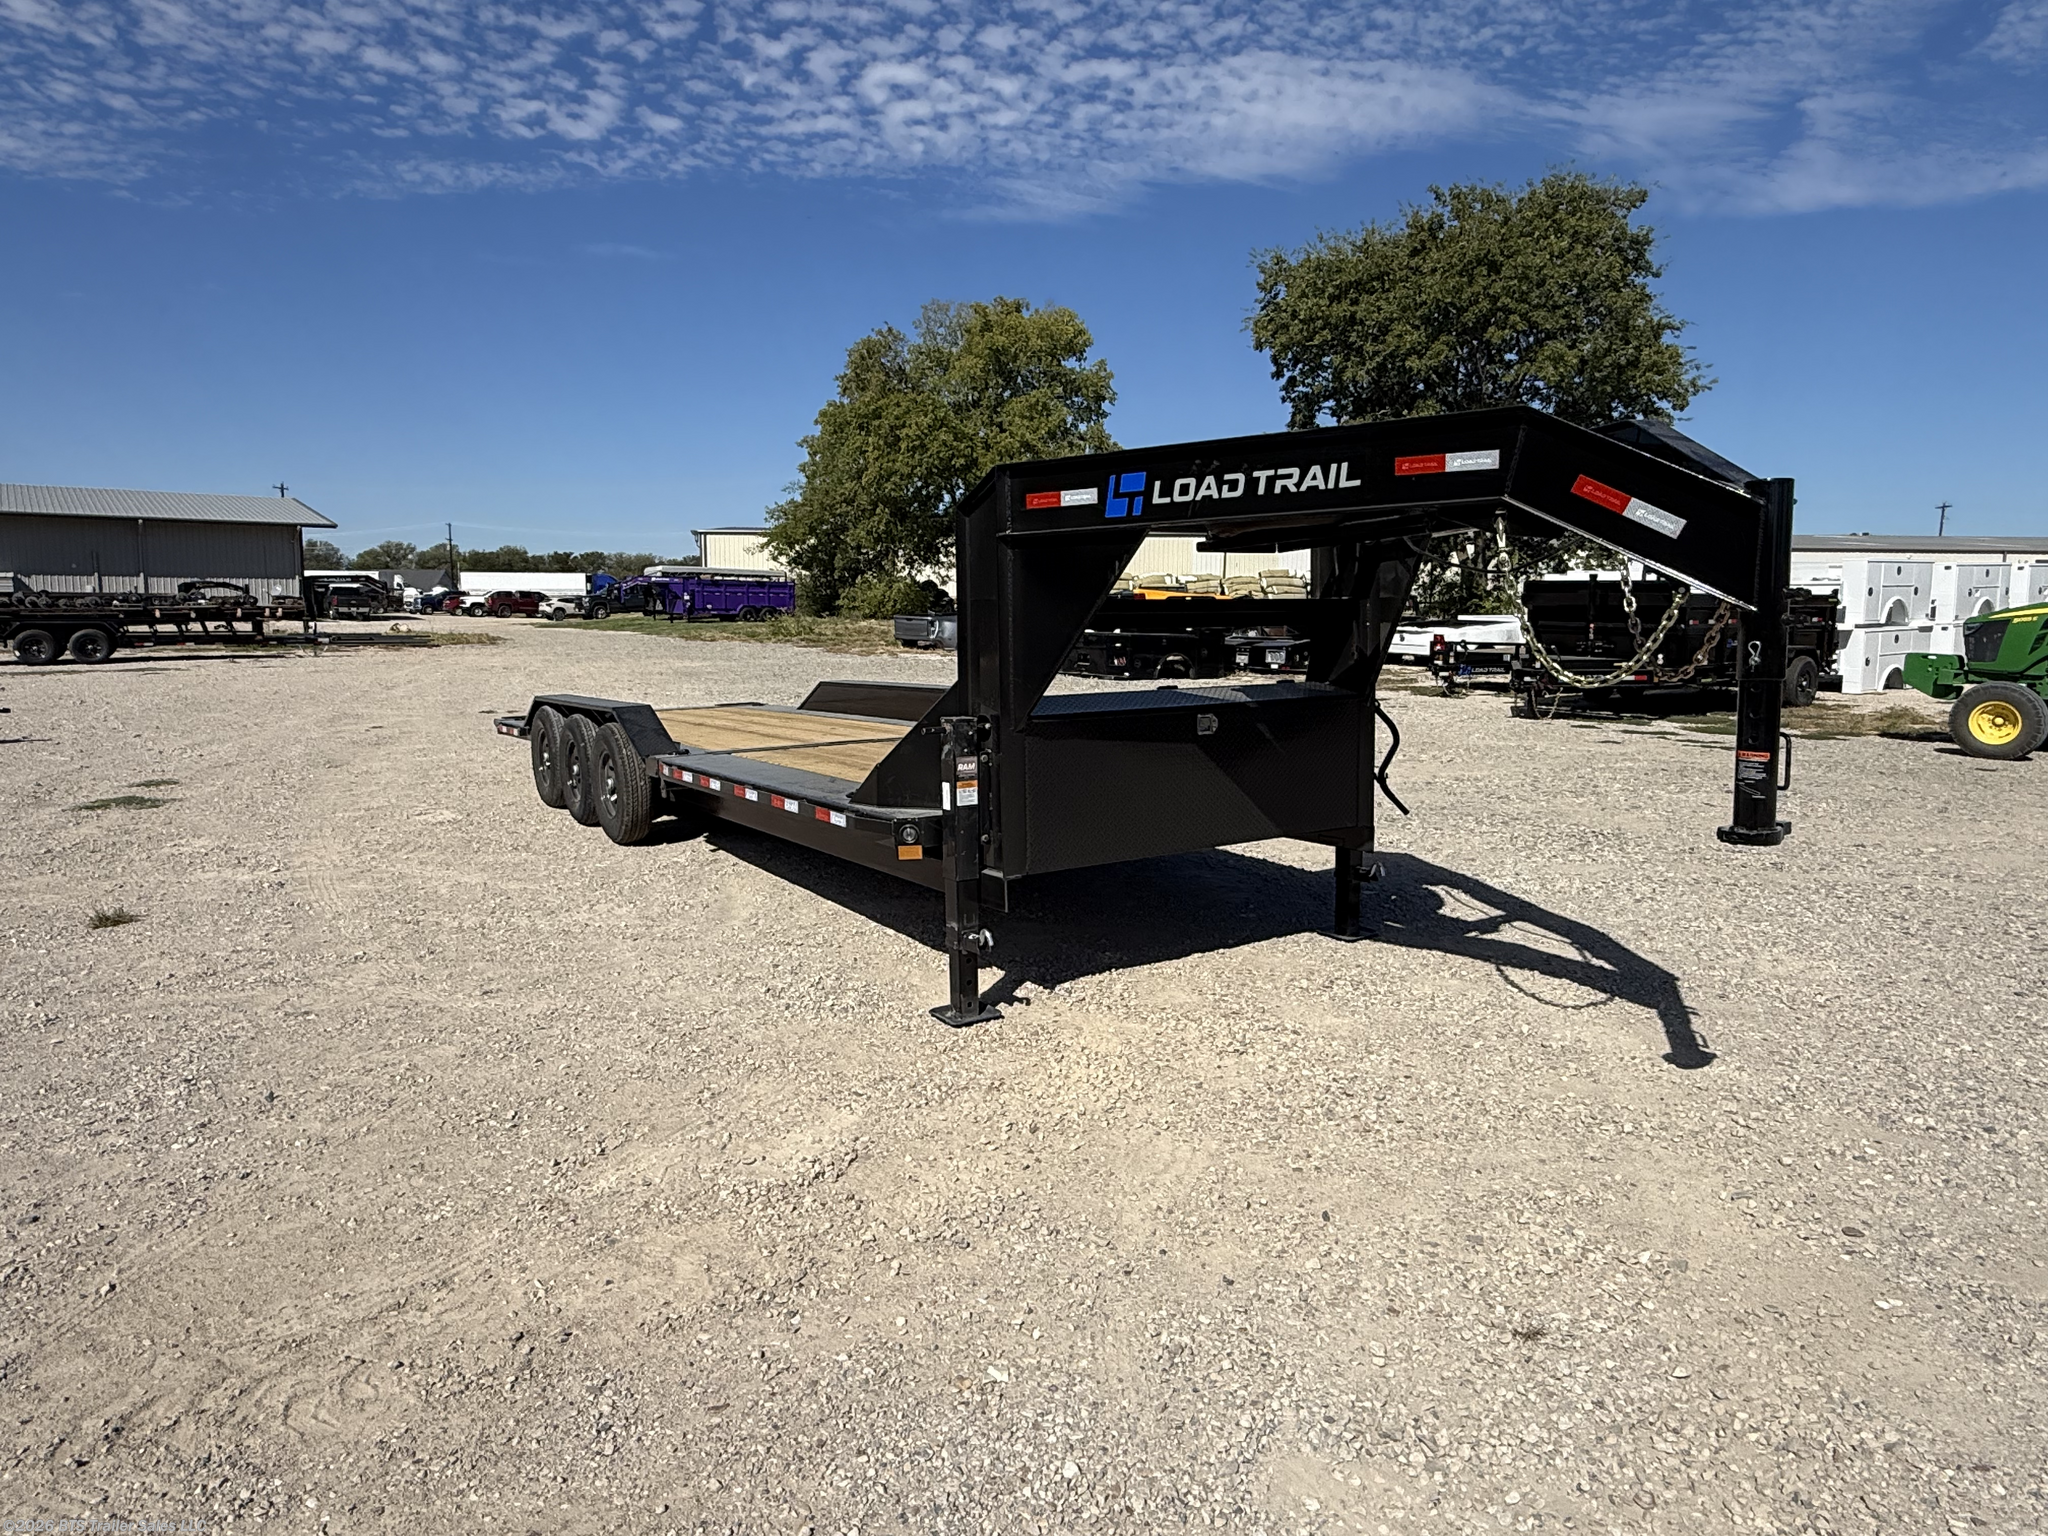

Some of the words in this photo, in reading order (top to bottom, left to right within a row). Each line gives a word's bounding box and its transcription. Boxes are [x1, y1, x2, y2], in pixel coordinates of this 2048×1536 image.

[1152, 472, 1246, 504] LOAD
[1252, 461, 1362, 495] TRAIL
[957, 762, 976, 771] RAM
